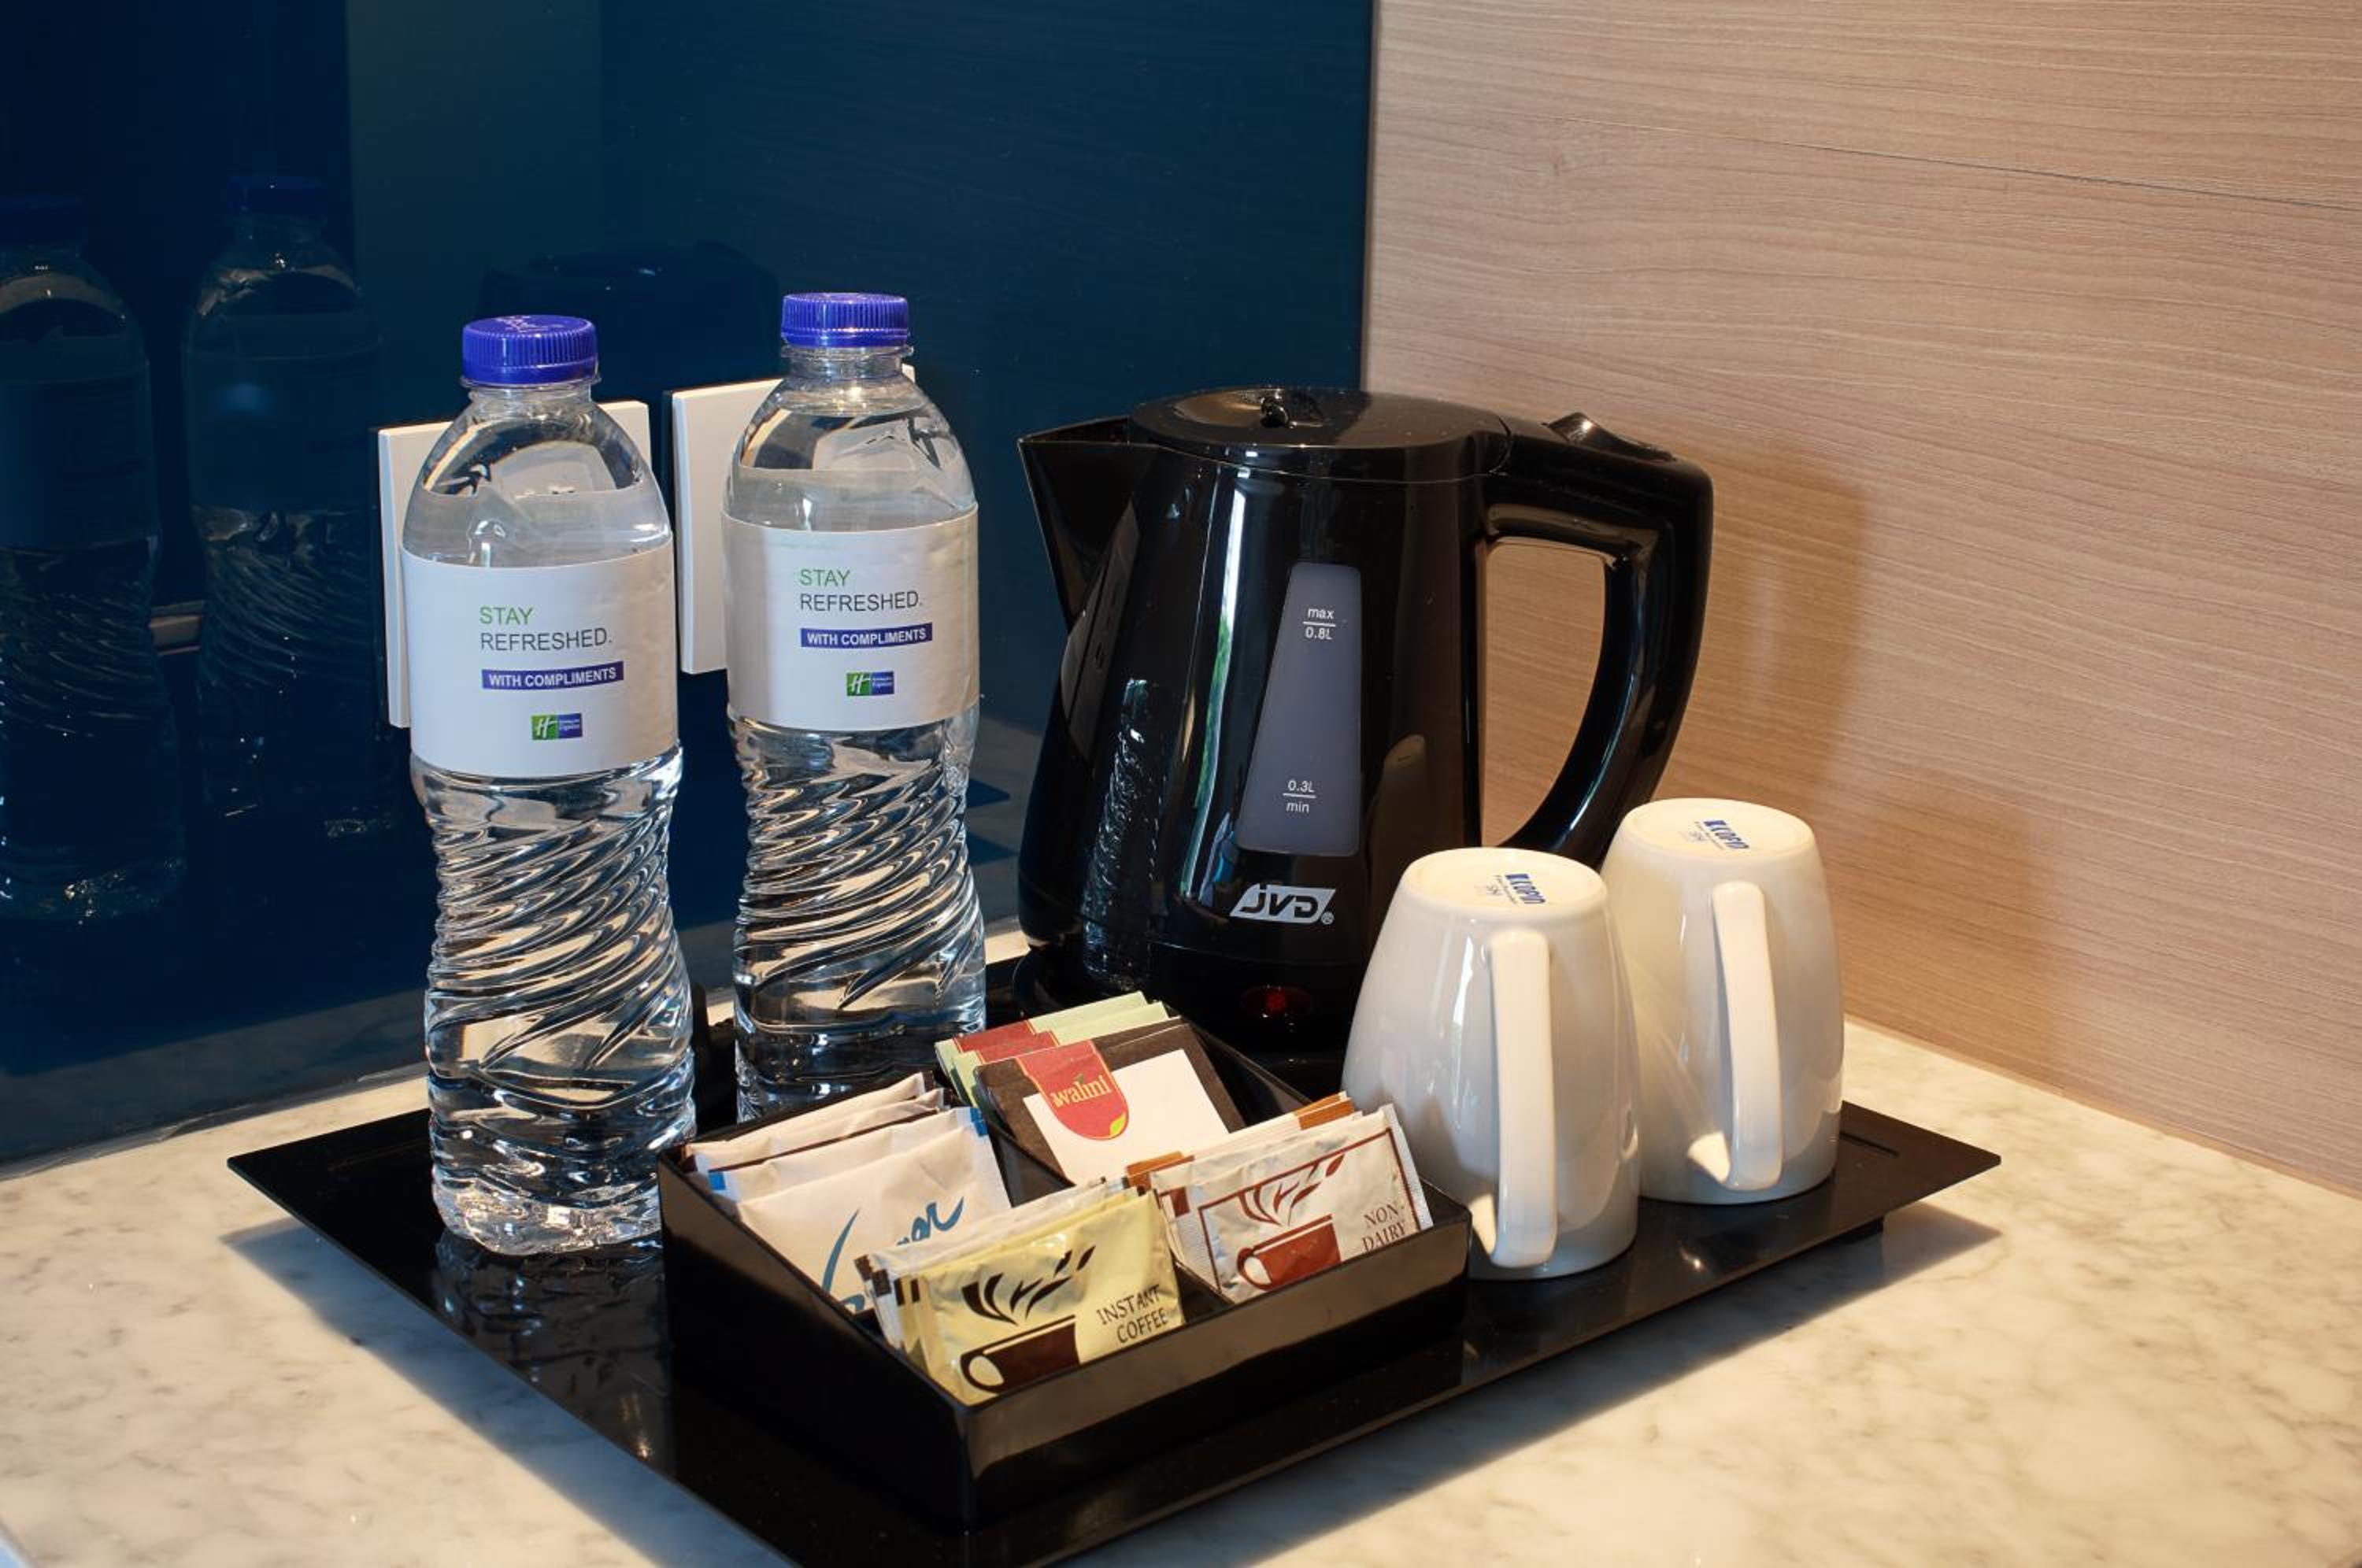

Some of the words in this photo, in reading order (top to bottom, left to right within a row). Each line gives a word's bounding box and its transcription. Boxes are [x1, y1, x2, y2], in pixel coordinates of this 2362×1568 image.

[799, 568, 850, 586] STAY
[800, 590, 923, 612] REFRESHED.
[479, 606, 533, 625] STAY
[1307, 608, 1335, 619] max
[480, 627, 613, 651] REFRESHED.
[807, 632, 838, 645] WITH
[841, 628, 926, 645] COMPLIMENTS
[1305, 627, 1332, 640] 0.8L
[489, 673, 522, 687] WITH
[524, 668, 616, 687] COMPLIMENTS
[1287, 780, 1316, 793] 0.3L
[1286, 801, 1309, 813] min
[1235, 882, 1326, 919] JVD
[1050, 1074, 1113, 1108] walini
[1360, 1218, 1405, 1255] DAIRY
[1096, 1283, 1161, 1326] INSTANT
[1116, 1307, 1169, 1344] COFFEE
